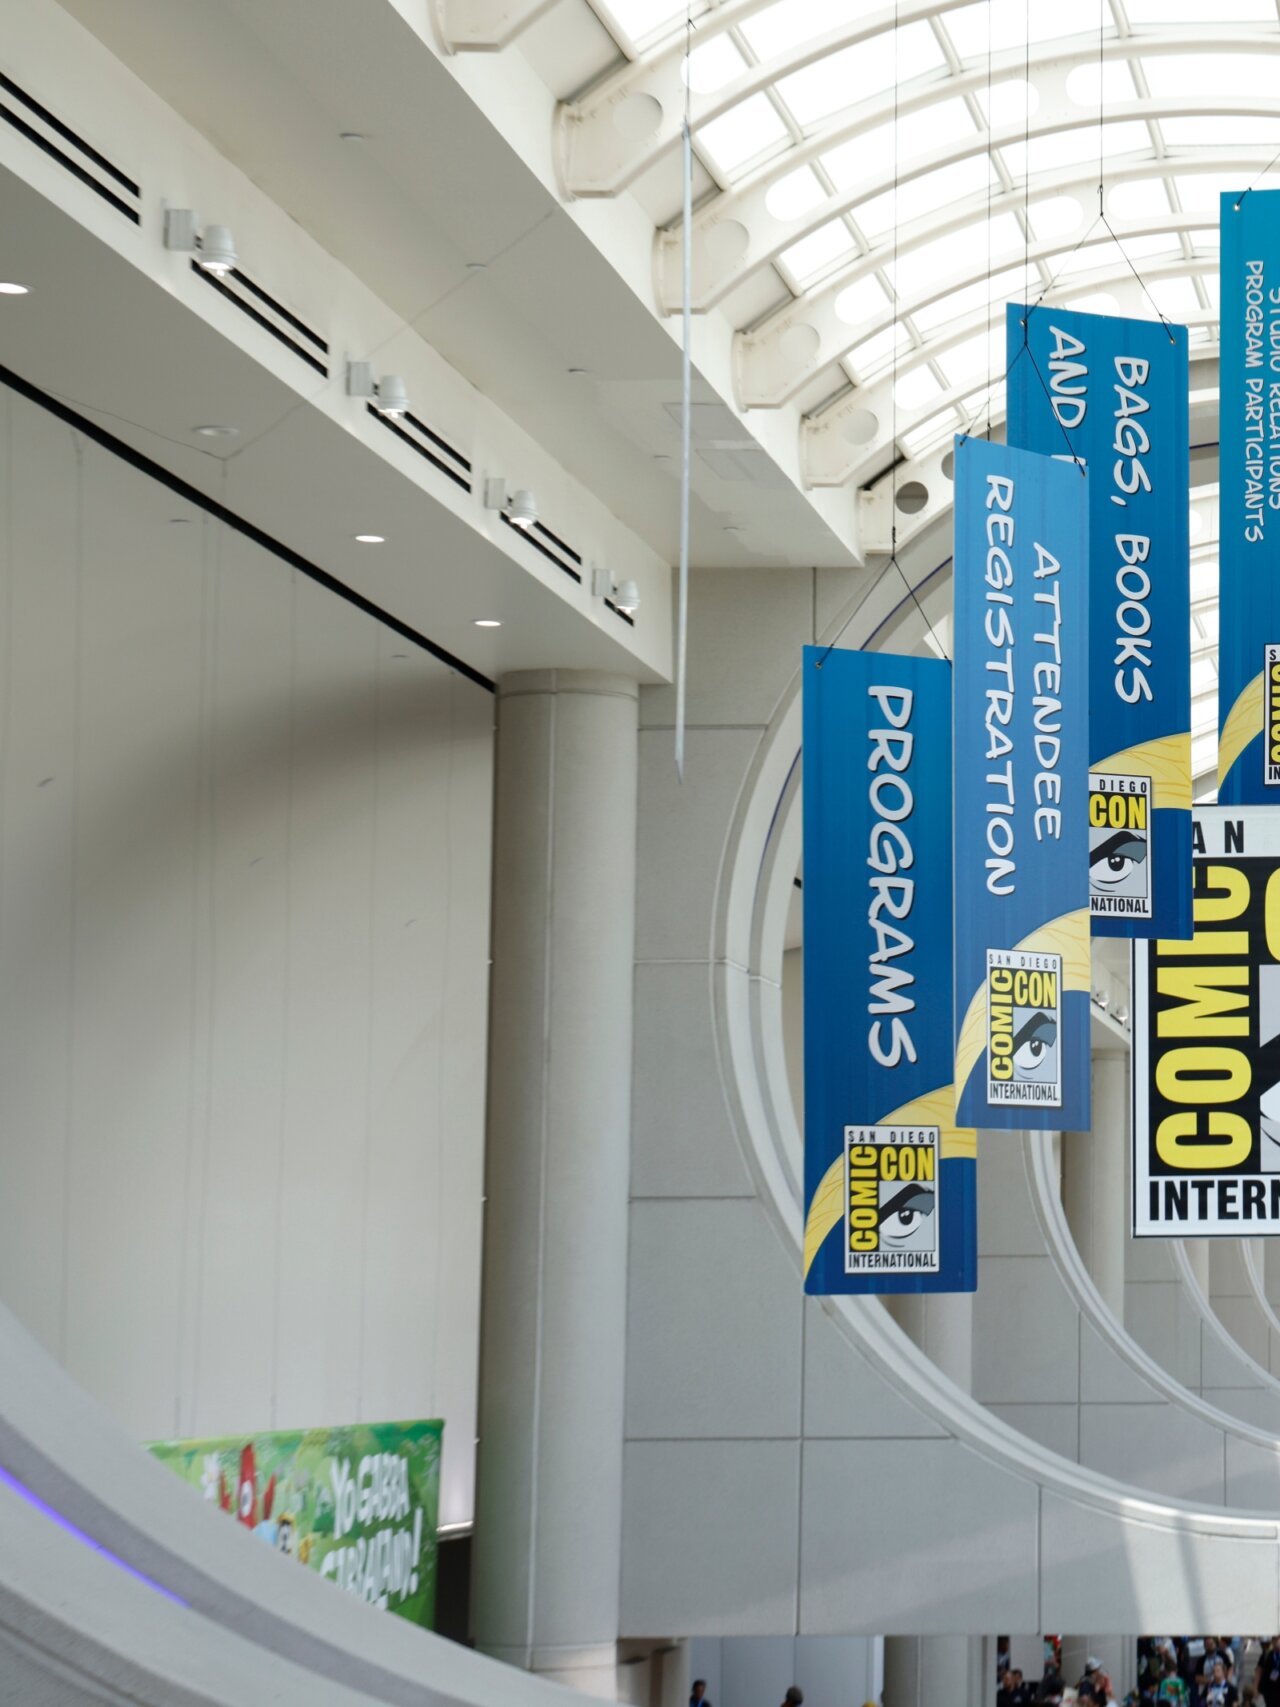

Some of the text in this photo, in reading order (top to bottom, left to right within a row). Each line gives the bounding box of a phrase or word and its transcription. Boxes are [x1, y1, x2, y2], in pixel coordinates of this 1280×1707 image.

[1048, 325, 1088, 429] AND
[1245, 260, 1264, 542] PROGRAM PARTICIPANTS
[1110, 356, 1154, 704] BAGS, BOOKS
[984, 474, 1016, 896] REGISTRATION
[1033, 542, 1062, 841] ATTENDEE
[1100, 779, 1147, 793] DIEGO
[1089, 794, 1146, 829] CON
[1193, 820, 1245, 854] AN
[867, 685, 917, 1068] PROGRAMS
[1091, 897, 1149, 913] NATIONAL
[989, 954, 1057, 970] SAN DIEGO
[1014, 970, 1056, 1008] CON
[991, 969, 1013, 1080] COMIC
[1155, 865, 1253, 1169] COMIC
[990, 1083, 1058, 1101] INTERNATIONAL
[848, 1131, 935, 1143] SAN DIEGO
[880, 1146, 934, 1181] CON
[850, 1146, 878, 1251] COMIC
[849, 1253, 936, 1268] INTERNATIONAL
